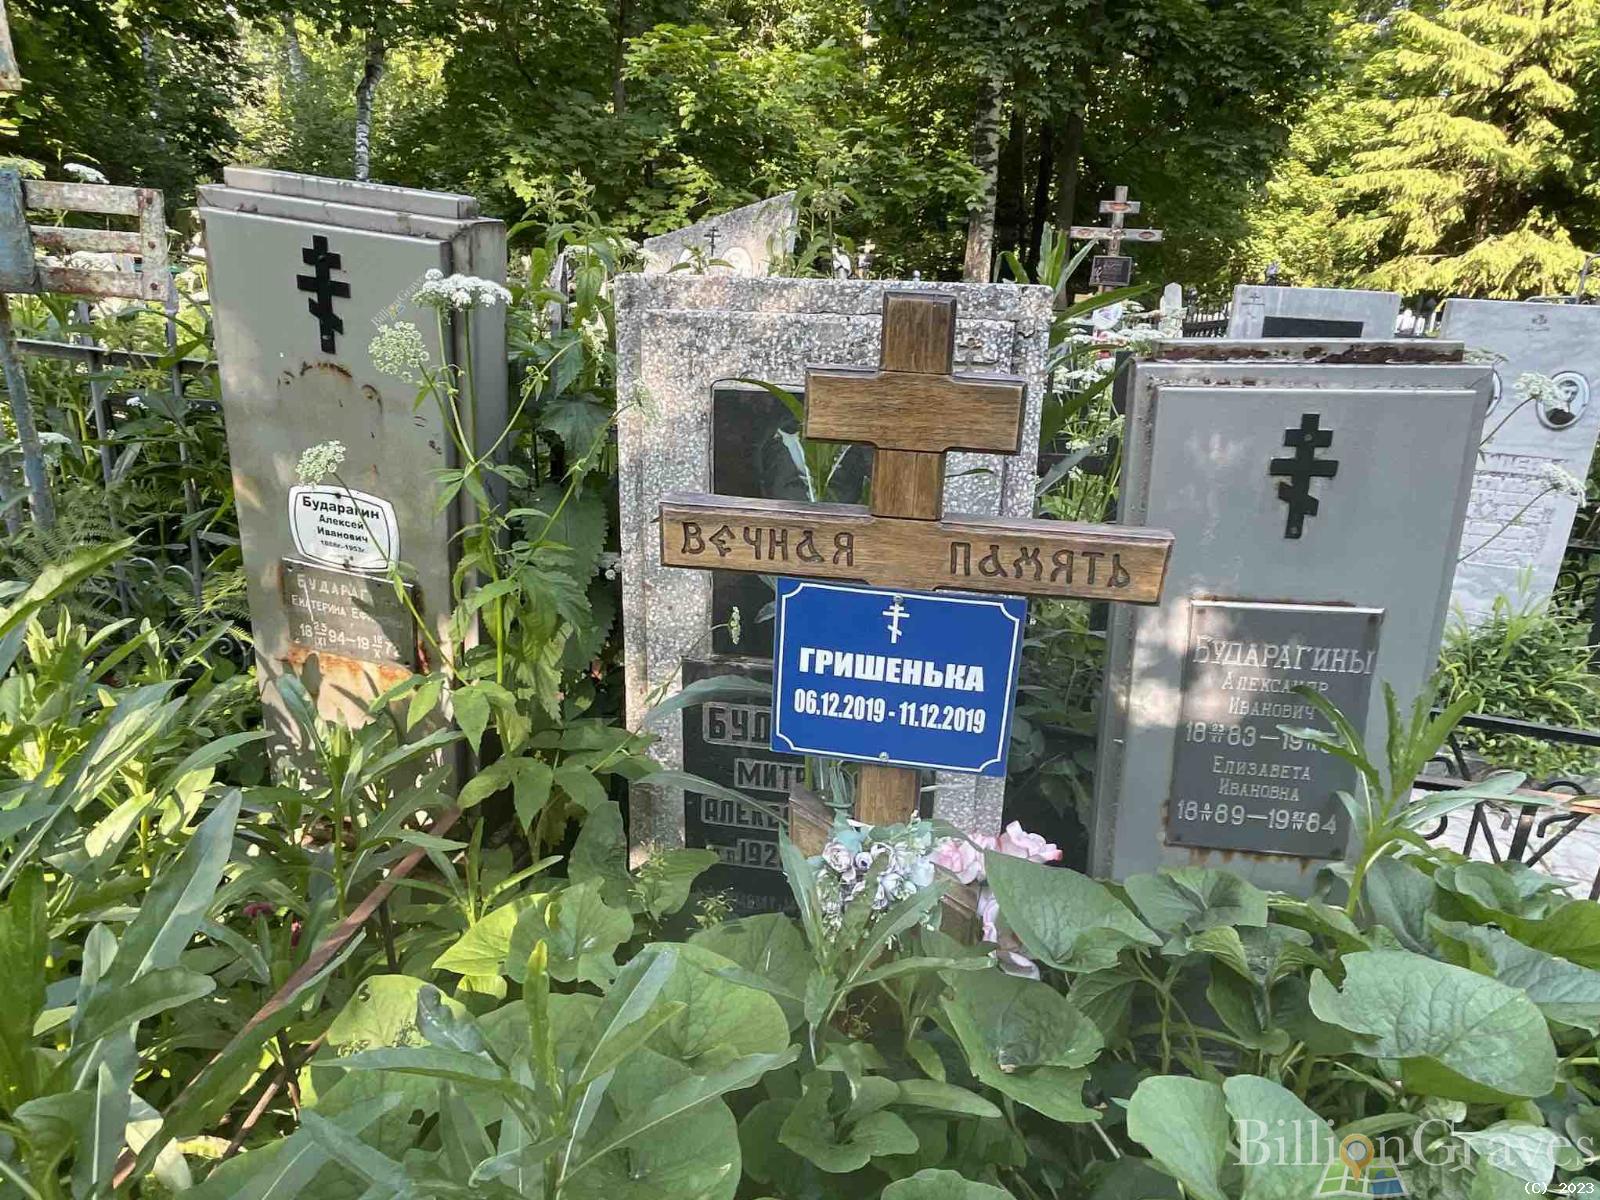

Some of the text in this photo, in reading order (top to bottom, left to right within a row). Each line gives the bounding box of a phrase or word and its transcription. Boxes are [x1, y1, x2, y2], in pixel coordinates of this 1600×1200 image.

[302, 495, 380, 519] Бударагин
[319, 514, 364, 530] Алексей
[317, 526, 368, 543] Иванович
[799, 647, 985, 692] ГРИШЕНЬКА
[1193, 635, 1377, 675] БУДАРАГИНЫ
[709, 706, 771, 743] БУД
[794, 688, 886, 723] 06.12.2019
[899, 701, 986, 734] 11.12.2019
